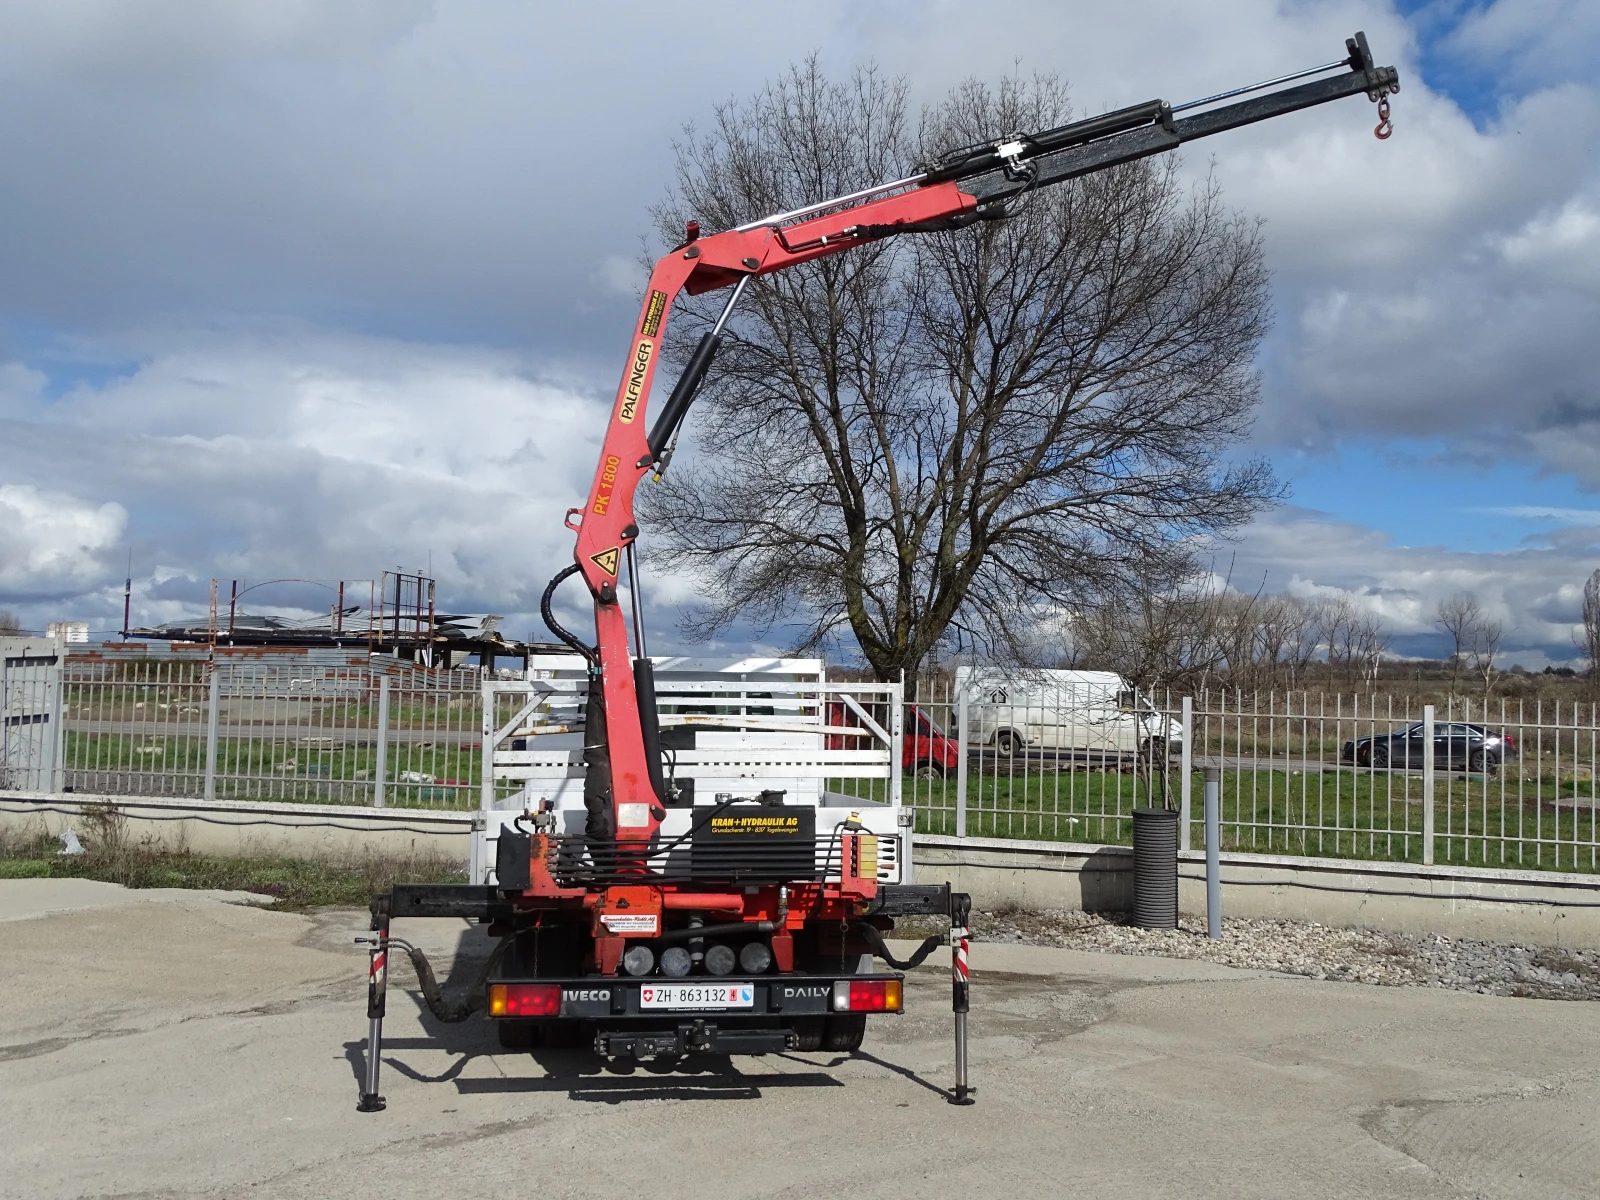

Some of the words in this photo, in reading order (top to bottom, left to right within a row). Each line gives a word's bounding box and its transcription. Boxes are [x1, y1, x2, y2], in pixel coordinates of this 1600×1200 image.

[621, 343, 652, 420] PALFINGER
[600, 456, 620, 489] 1800
[593, 493, 610, 515] PK
[786, 818, 798, 826] AG
[563, 990, 610, 1002] IVECO
[657, 989, 671, 1002] ZH
[680, 989, 726, 1002] 863132
[784, 987, 830, 998] DAILY
